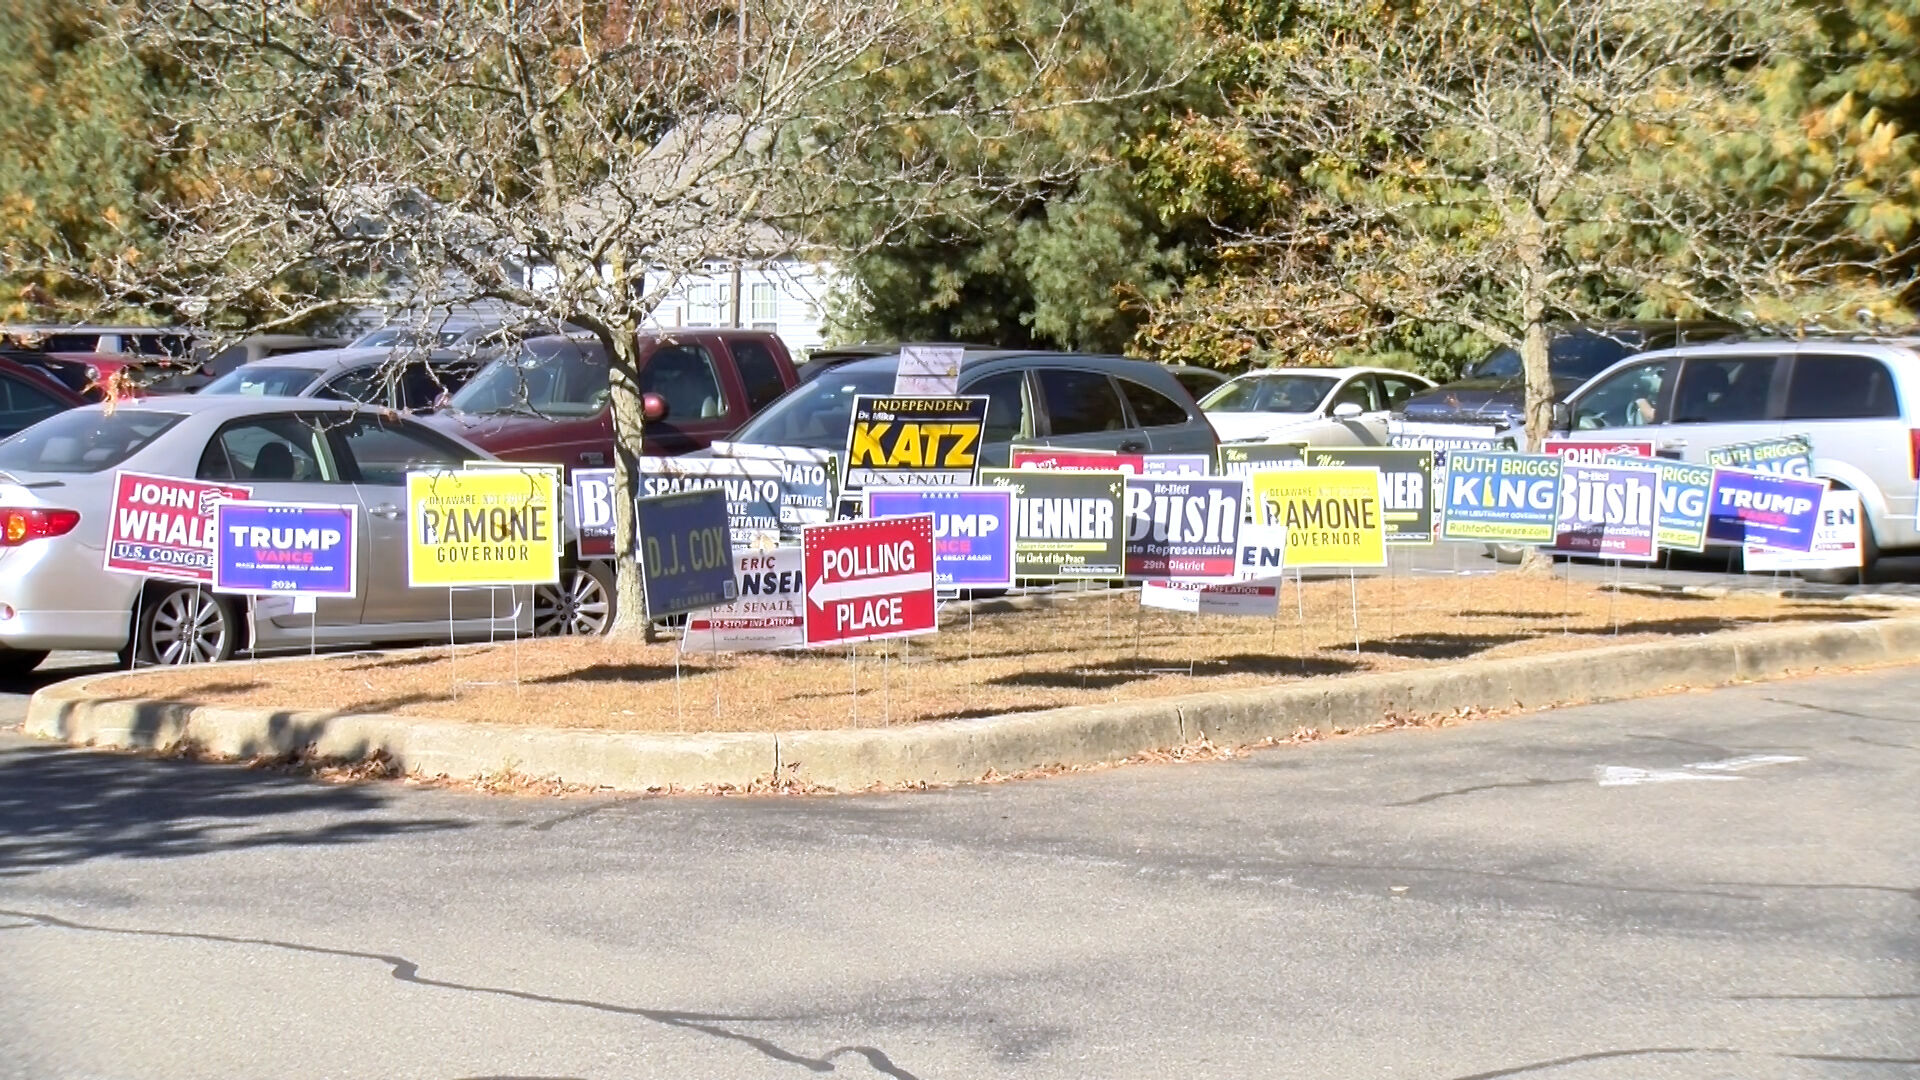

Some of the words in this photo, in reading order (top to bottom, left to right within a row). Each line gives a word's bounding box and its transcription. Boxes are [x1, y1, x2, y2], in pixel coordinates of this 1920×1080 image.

[872, 399, 973, 411] INDEPENDENT
[851, 422, 980, 467] KATZ
[1711, 447, 1751, 466] RUTH
[1753, 441, 1809, 462] BRIGGS
[1452, 456, 1497, 473] RUTH
[1501, 458, 1559, 476] BRIGGS
[1662, 465, 1710, 486] RIGGS
[899, 474, 958, 485] SENATE
[128, 482, 195, 509] JOHN
[1559, 474, 1651, 526] Bush
[1718, 487, 1813, 516] TRUMP
[727, 502, 748, 515] ATE
[1016, 498, 1114, 539] IENNER
[1126, 487, 1236, 543] Bush
[1265, 498, 1376, 530] RAMONE
[119, 507, 214, 549] WHALE
[423, 506, 548, 544] RAMONE
[935, 513, 999, 538] UMP
[228, 525, 342, 551] TRUMP
[1286, 532, 1361, 547] OVERNOR
[118, 544, 146, 560] U.S.
[148, 548, 214, 569] CONGRE
[255, 549, 314, 564] VANCE
[437, 545, 529, 563] GOVERNOR
[647, 533, 687, 578] D.J.
[689, 526, 728, 571] COX
[823, 540, 915, 579] POLLING
[1016, 552, 1026, 563] for
[1044, 552, 1053, 563] of
[1053, 552, 1064, 563] the
[1065, 553, 1085, 564] Peace
[1147, 544, 1234, 557] Representative
[741, 556, 776, 571] ERIC
[1143, 560, 1165, 569] 29th
[1168, 560, 1206, 571] District
[271, 580, 297, 590] 2024
[1209, 584, 1260, 595] INFLATION
[744, 599, 793, 613] SENATE
[837, 597, 904, 632] PLACE
[710, 619, 721, 629] TO
[724, 619, 748, 629] STOP
[749, 616, 795, 628] INFLATION
